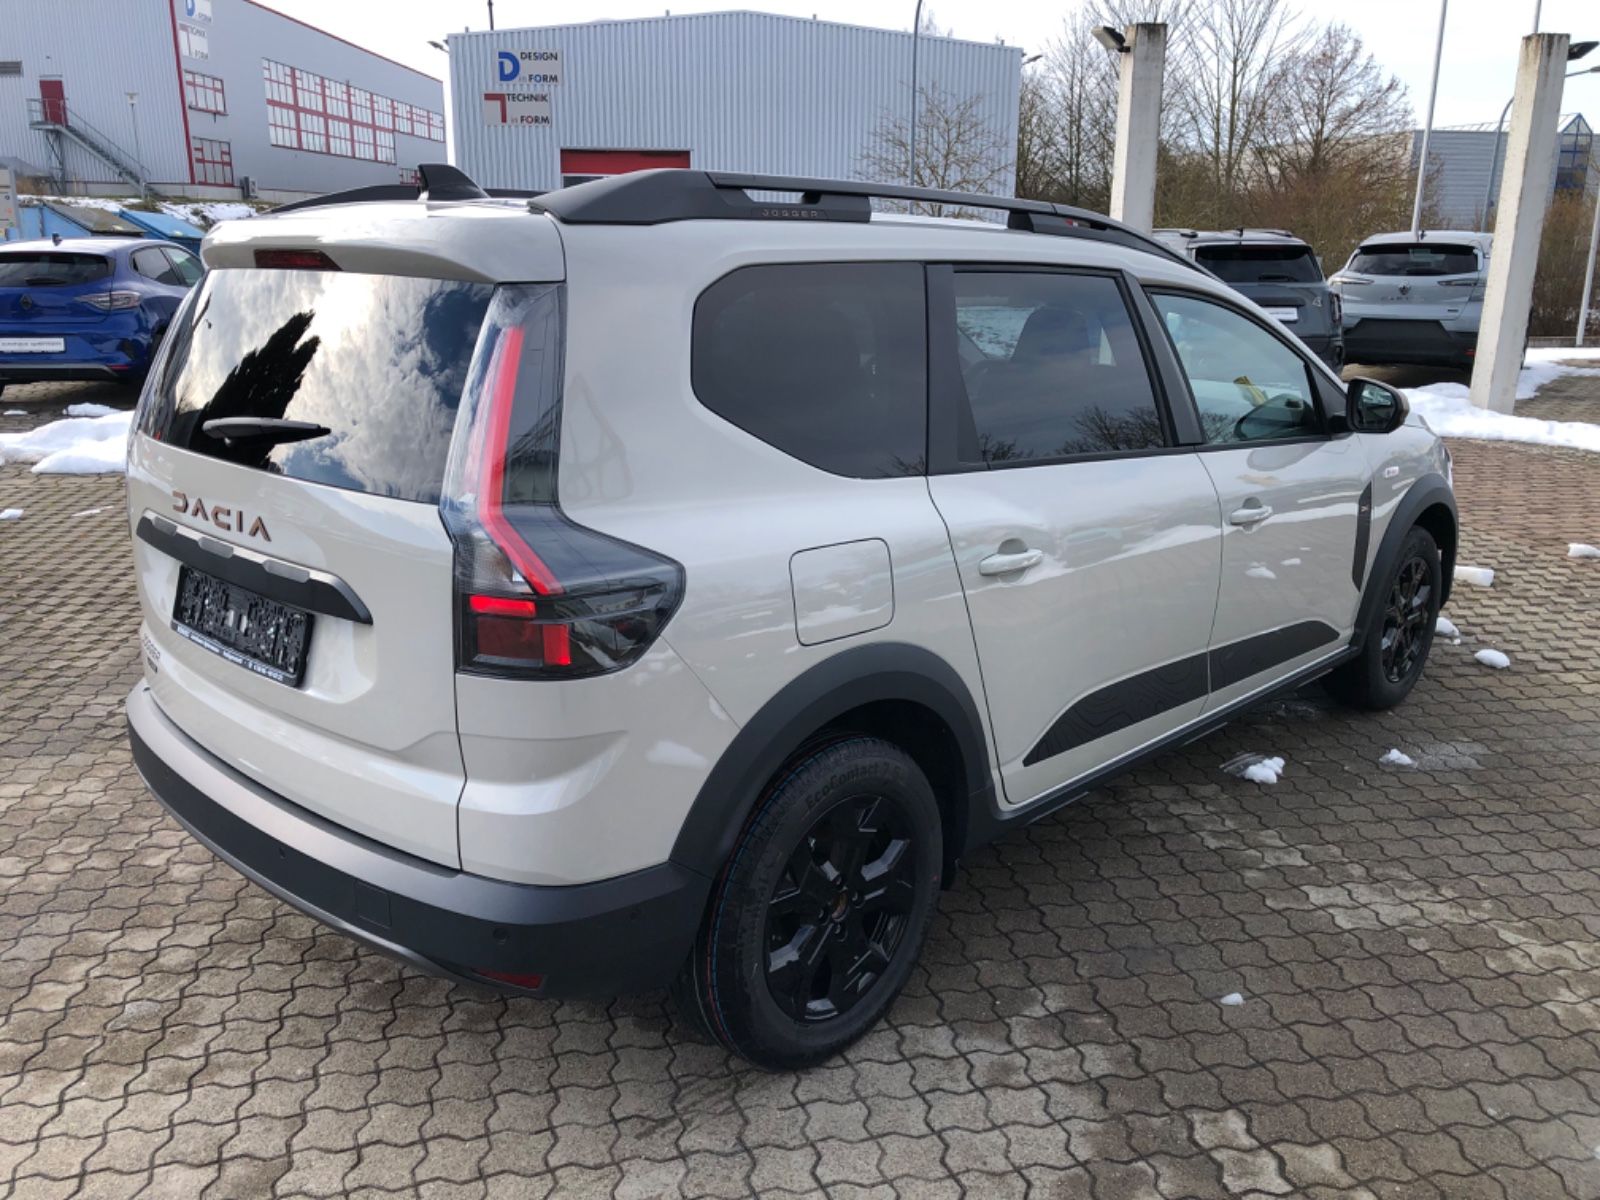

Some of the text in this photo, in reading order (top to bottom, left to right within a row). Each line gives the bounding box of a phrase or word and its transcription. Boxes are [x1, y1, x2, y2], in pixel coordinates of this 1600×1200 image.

[520, 51, 558, 61] DESIGN
[528, 74, 558, 83] FORM
[506, 93, 548, 102] TECHNIK
[520, 115, 550, 124] FORM
[762, 209, 818, 218] JOGGER
[172, 490, 272, 543] DACIA
